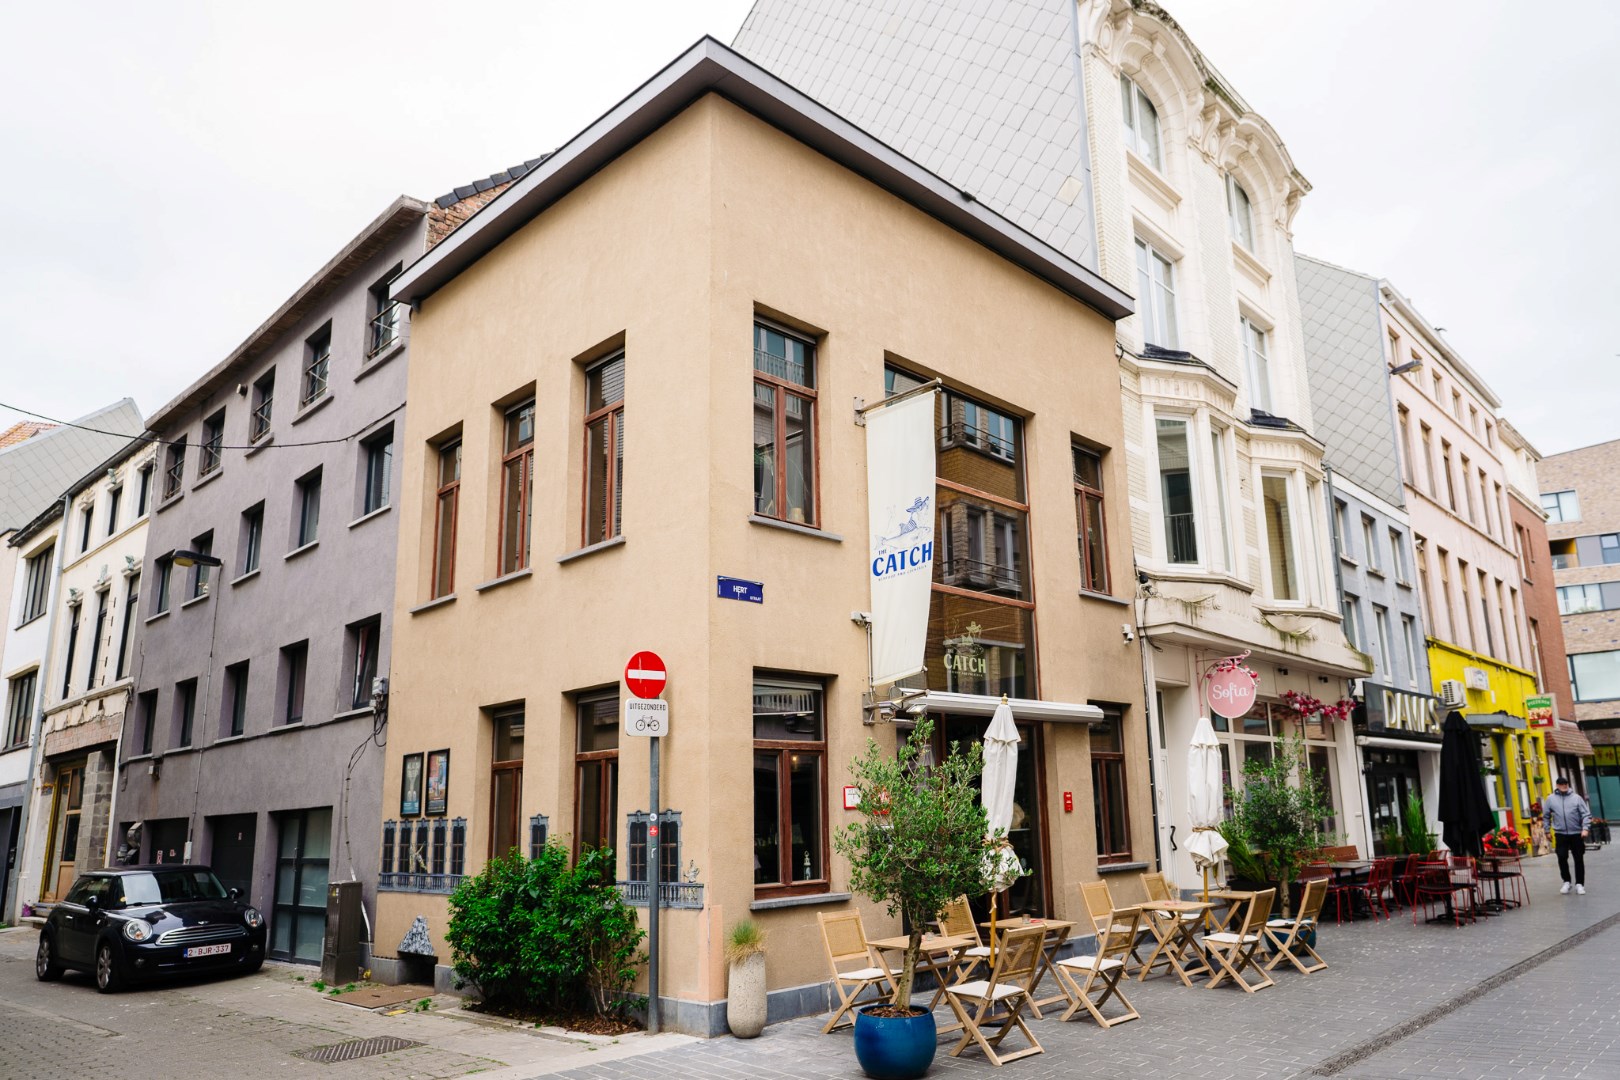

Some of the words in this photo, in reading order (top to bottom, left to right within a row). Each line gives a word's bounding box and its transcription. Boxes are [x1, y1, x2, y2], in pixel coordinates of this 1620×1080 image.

[872, 541, 933, 577] CATCH
[732, 585, 748, 594] HERT
[943, 653, 987, 674] CATCH
[1212, 682, 1250, 704] Sofia
[629, 702, 667, 711] UITGEZONDERD
